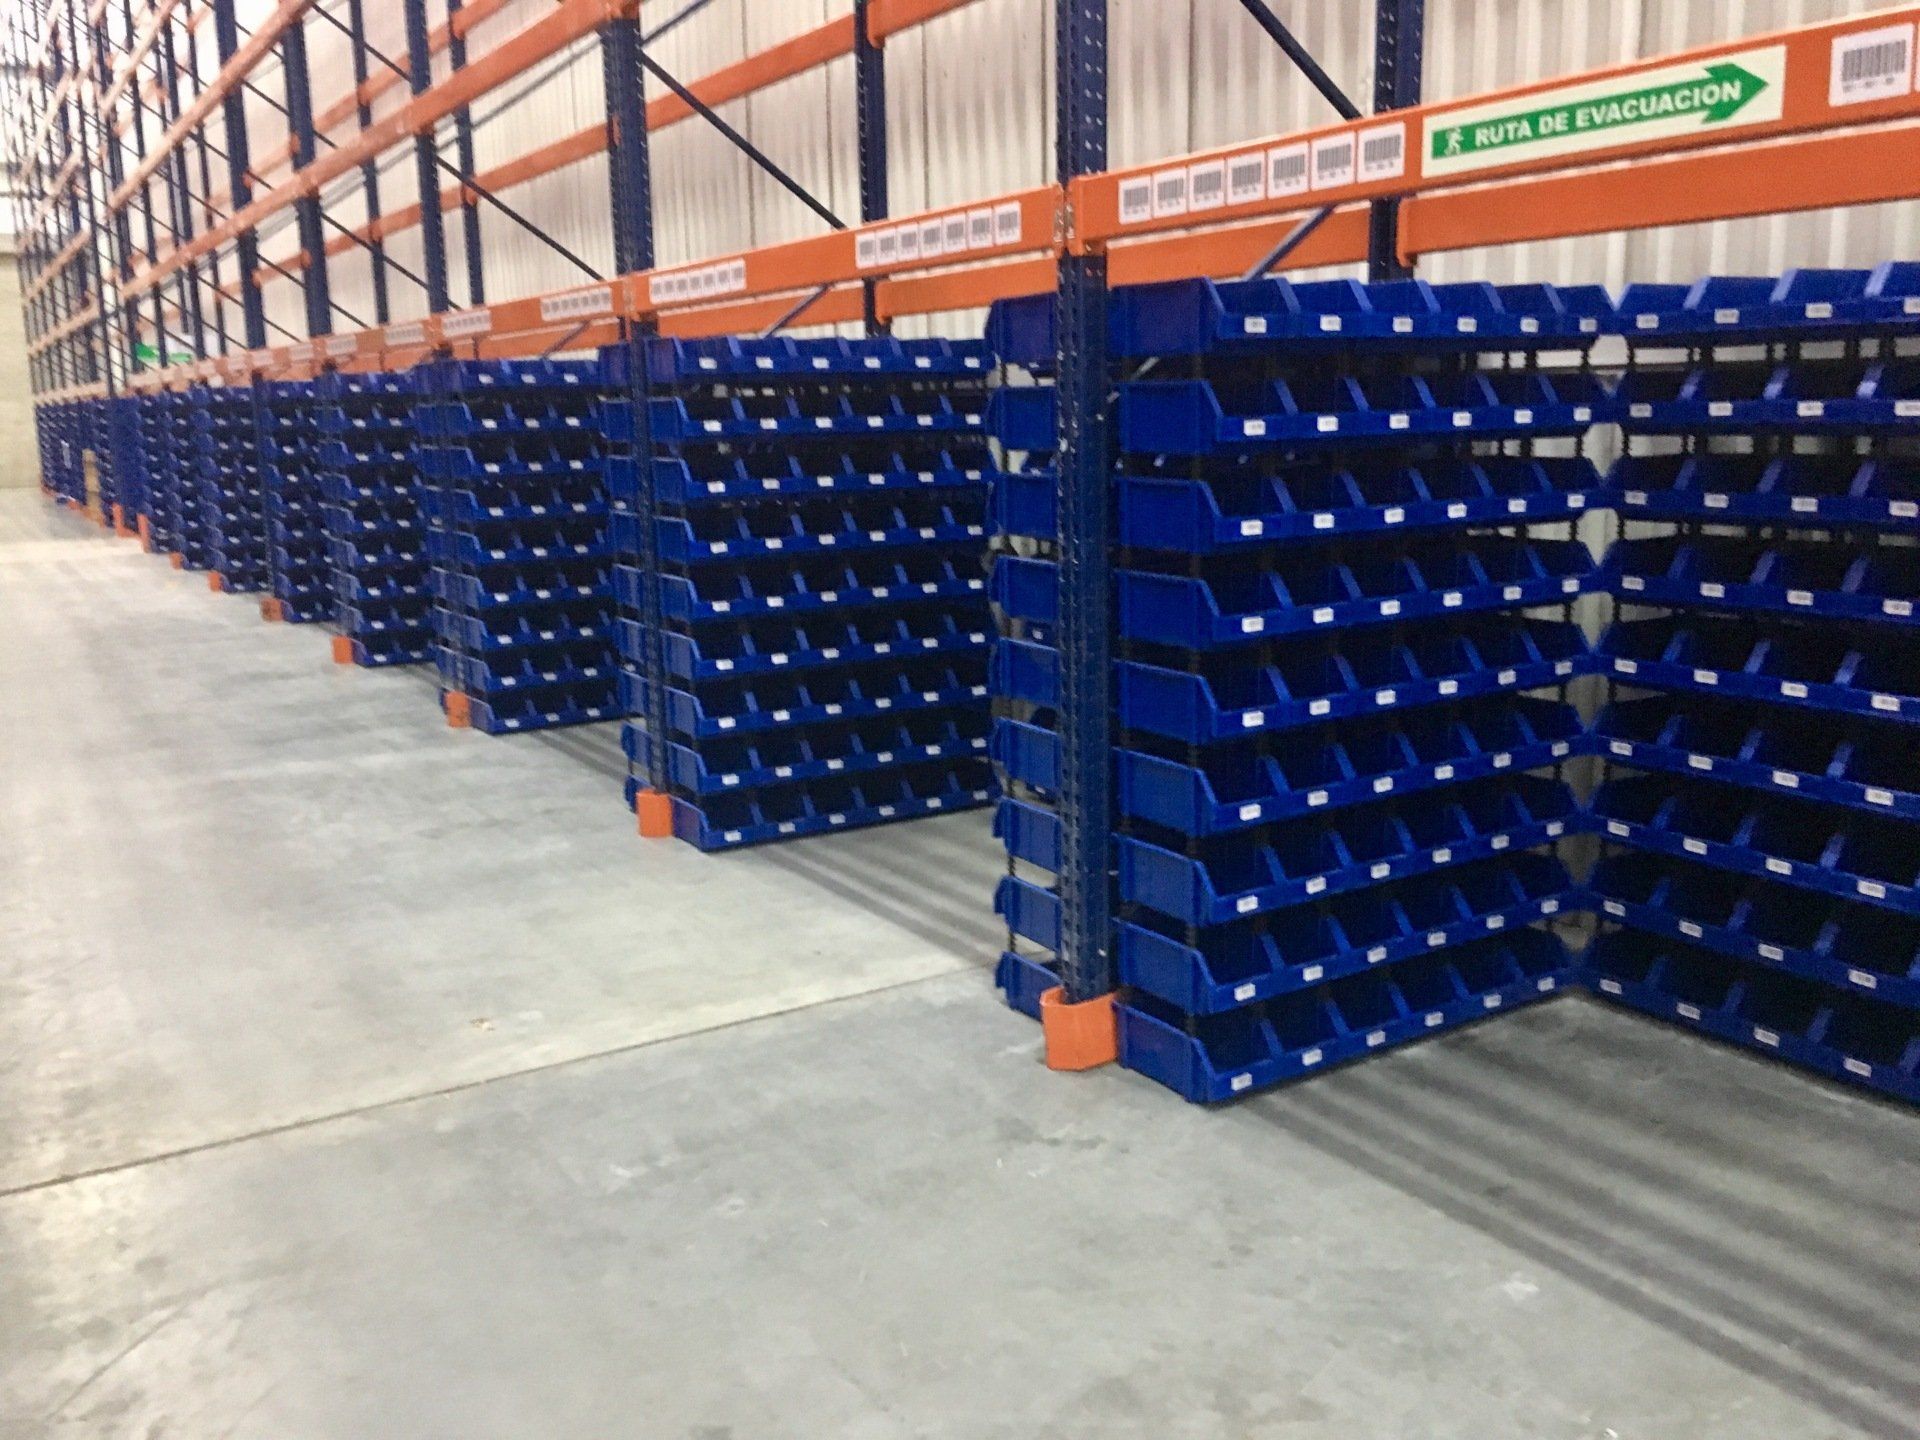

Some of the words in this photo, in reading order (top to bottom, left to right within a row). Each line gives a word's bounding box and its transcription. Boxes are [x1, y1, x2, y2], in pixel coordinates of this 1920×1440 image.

[1475, 118, 1532, 147] RUTA
[1538, 111, 1569, 134] DE
[1575, 79, 1742, 127] EVACUACION
